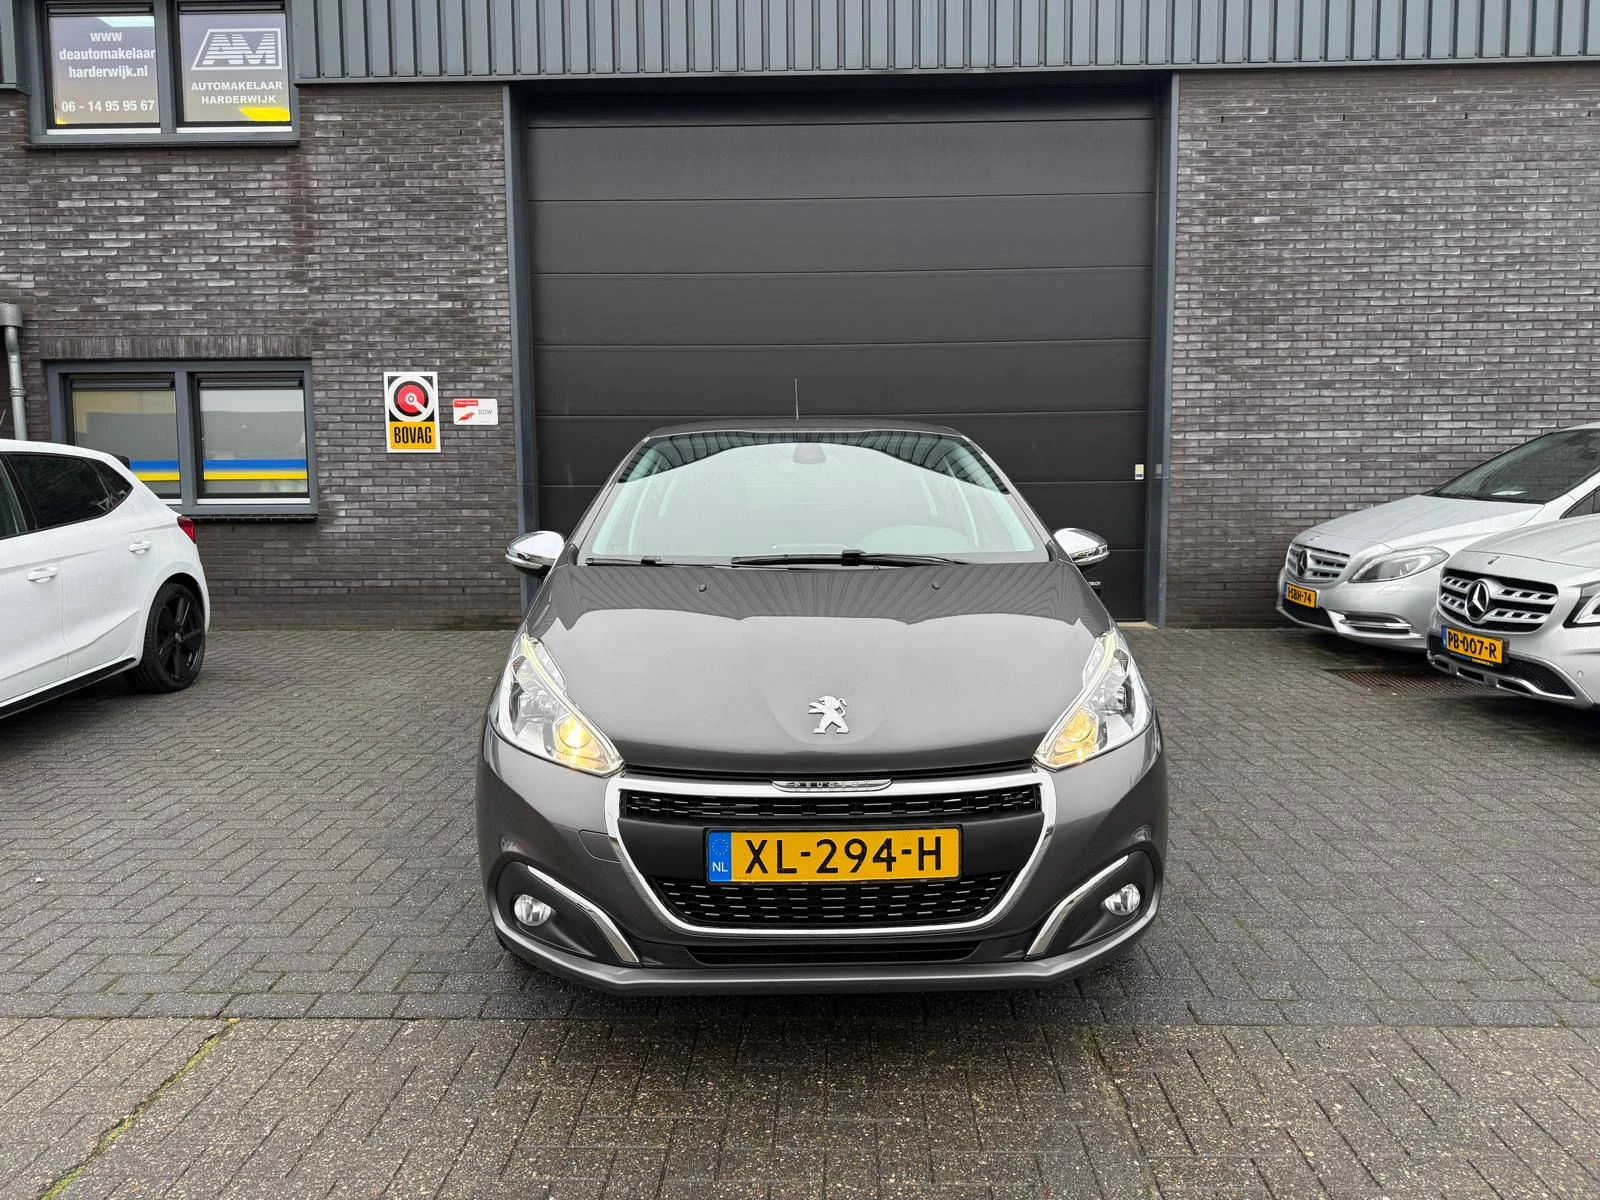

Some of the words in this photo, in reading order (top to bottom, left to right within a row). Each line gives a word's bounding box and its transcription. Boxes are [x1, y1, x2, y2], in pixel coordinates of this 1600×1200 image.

[90, 32, 122, 42] www
[59, 48, 156, 61] deautomakelaar
[202, 33, 276, 65] AM
[68, 65, 148, 79] harderwijk.nl
[191, 81, 283, 91] AUTOMAKELAAR
[61, 101, 75, 112] 06
[88, 101, 101, 112] 14
[105, 101, 119, 112] 95
[123, 101, 137, 112] 95
[141, 100, 154, 111] 67
[201, 95, 276, 105] HARDERWIJK
[394, 426, 432, 444] BOVAG
[1448, 631, 1497, 659] PB-007-R
[745, 836, 941, 874] XL-294-H
[712, 861, 728, 872] NL
